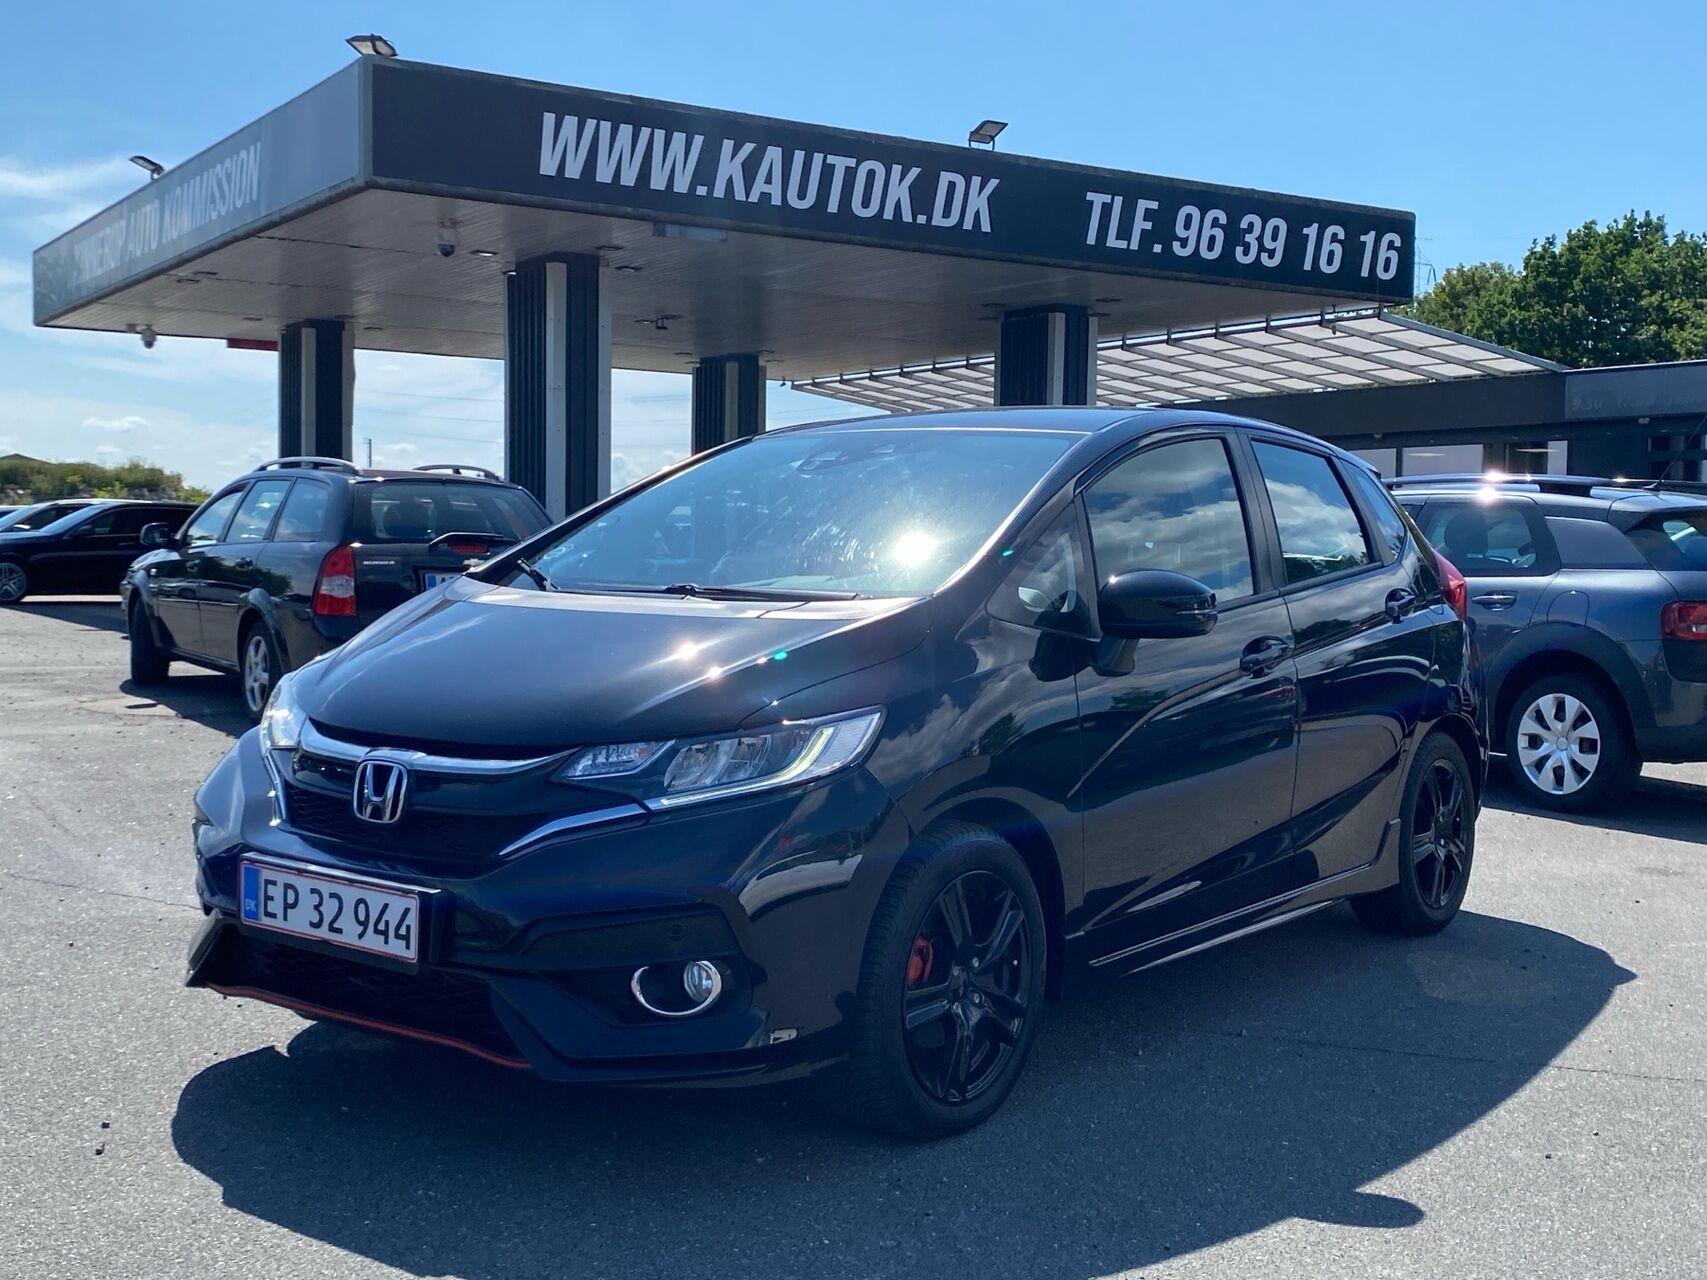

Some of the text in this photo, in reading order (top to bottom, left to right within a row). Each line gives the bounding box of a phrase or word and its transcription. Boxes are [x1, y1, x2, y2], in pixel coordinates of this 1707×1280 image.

[126, 200, 161, 261] AUTO
[163, 143, 262, 244] KOMMISSION
[539, 112, 1000, 233] WWW.KAUTOK.DK
[1085, 192, 1401, 281] TLF. 96 39 16 16
[263, 878, 411, 950] EP 32 944
